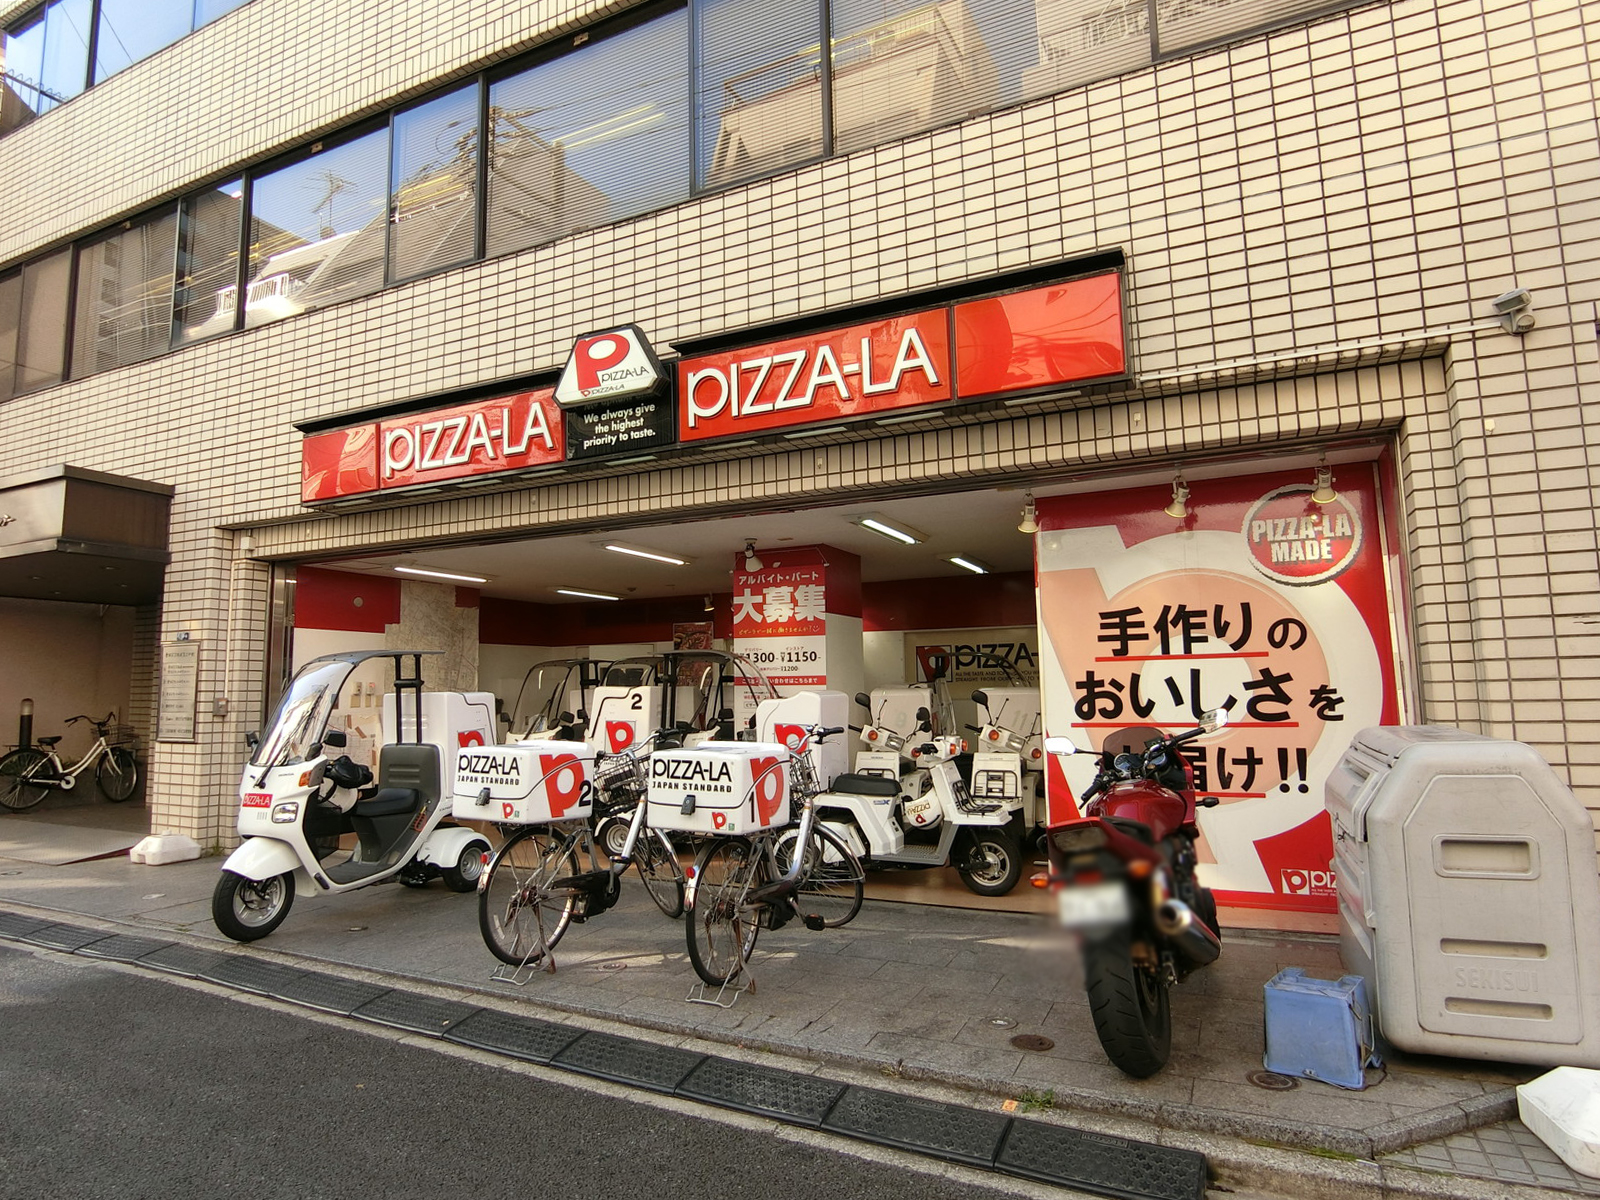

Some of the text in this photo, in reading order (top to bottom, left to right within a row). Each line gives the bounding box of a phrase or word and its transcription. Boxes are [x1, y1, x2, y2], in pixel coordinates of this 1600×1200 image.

[601, 365, 649, 383] PIZZA-LA
[687, 328, 940, 428] PIZZA-LA
[583, 414, 599, 424] We
[601, 408, 633, 420] always
[635, 402, 655, 416] give
[595, 417, 644, 434] the highest
[385, 402, 555, 478] PIZZA-LA
[583, 428, 656, 450] priority to taste.
[1252, 516, 1351, 544] PIZZA-LA
[1270, 538, 1333, 564] MADE
[734, 584, 825, 625] 大募集
[1097, 602, 1307, 657] 手作りの
[631, 693, 642, 710] 2
[1074, 667, 1345, 721] おいしさを
[458, 754, 520, 776] PIZZA-LA
[653, 758, 732, 782] PIZZA-LA
[458, 775, 520, 786] JAPAN STANDARD
[683, 783, 732, 793] STANDARD
[578, 780, 591, 807] 2
[1454, 966, 1539, 992] SEKISUI
